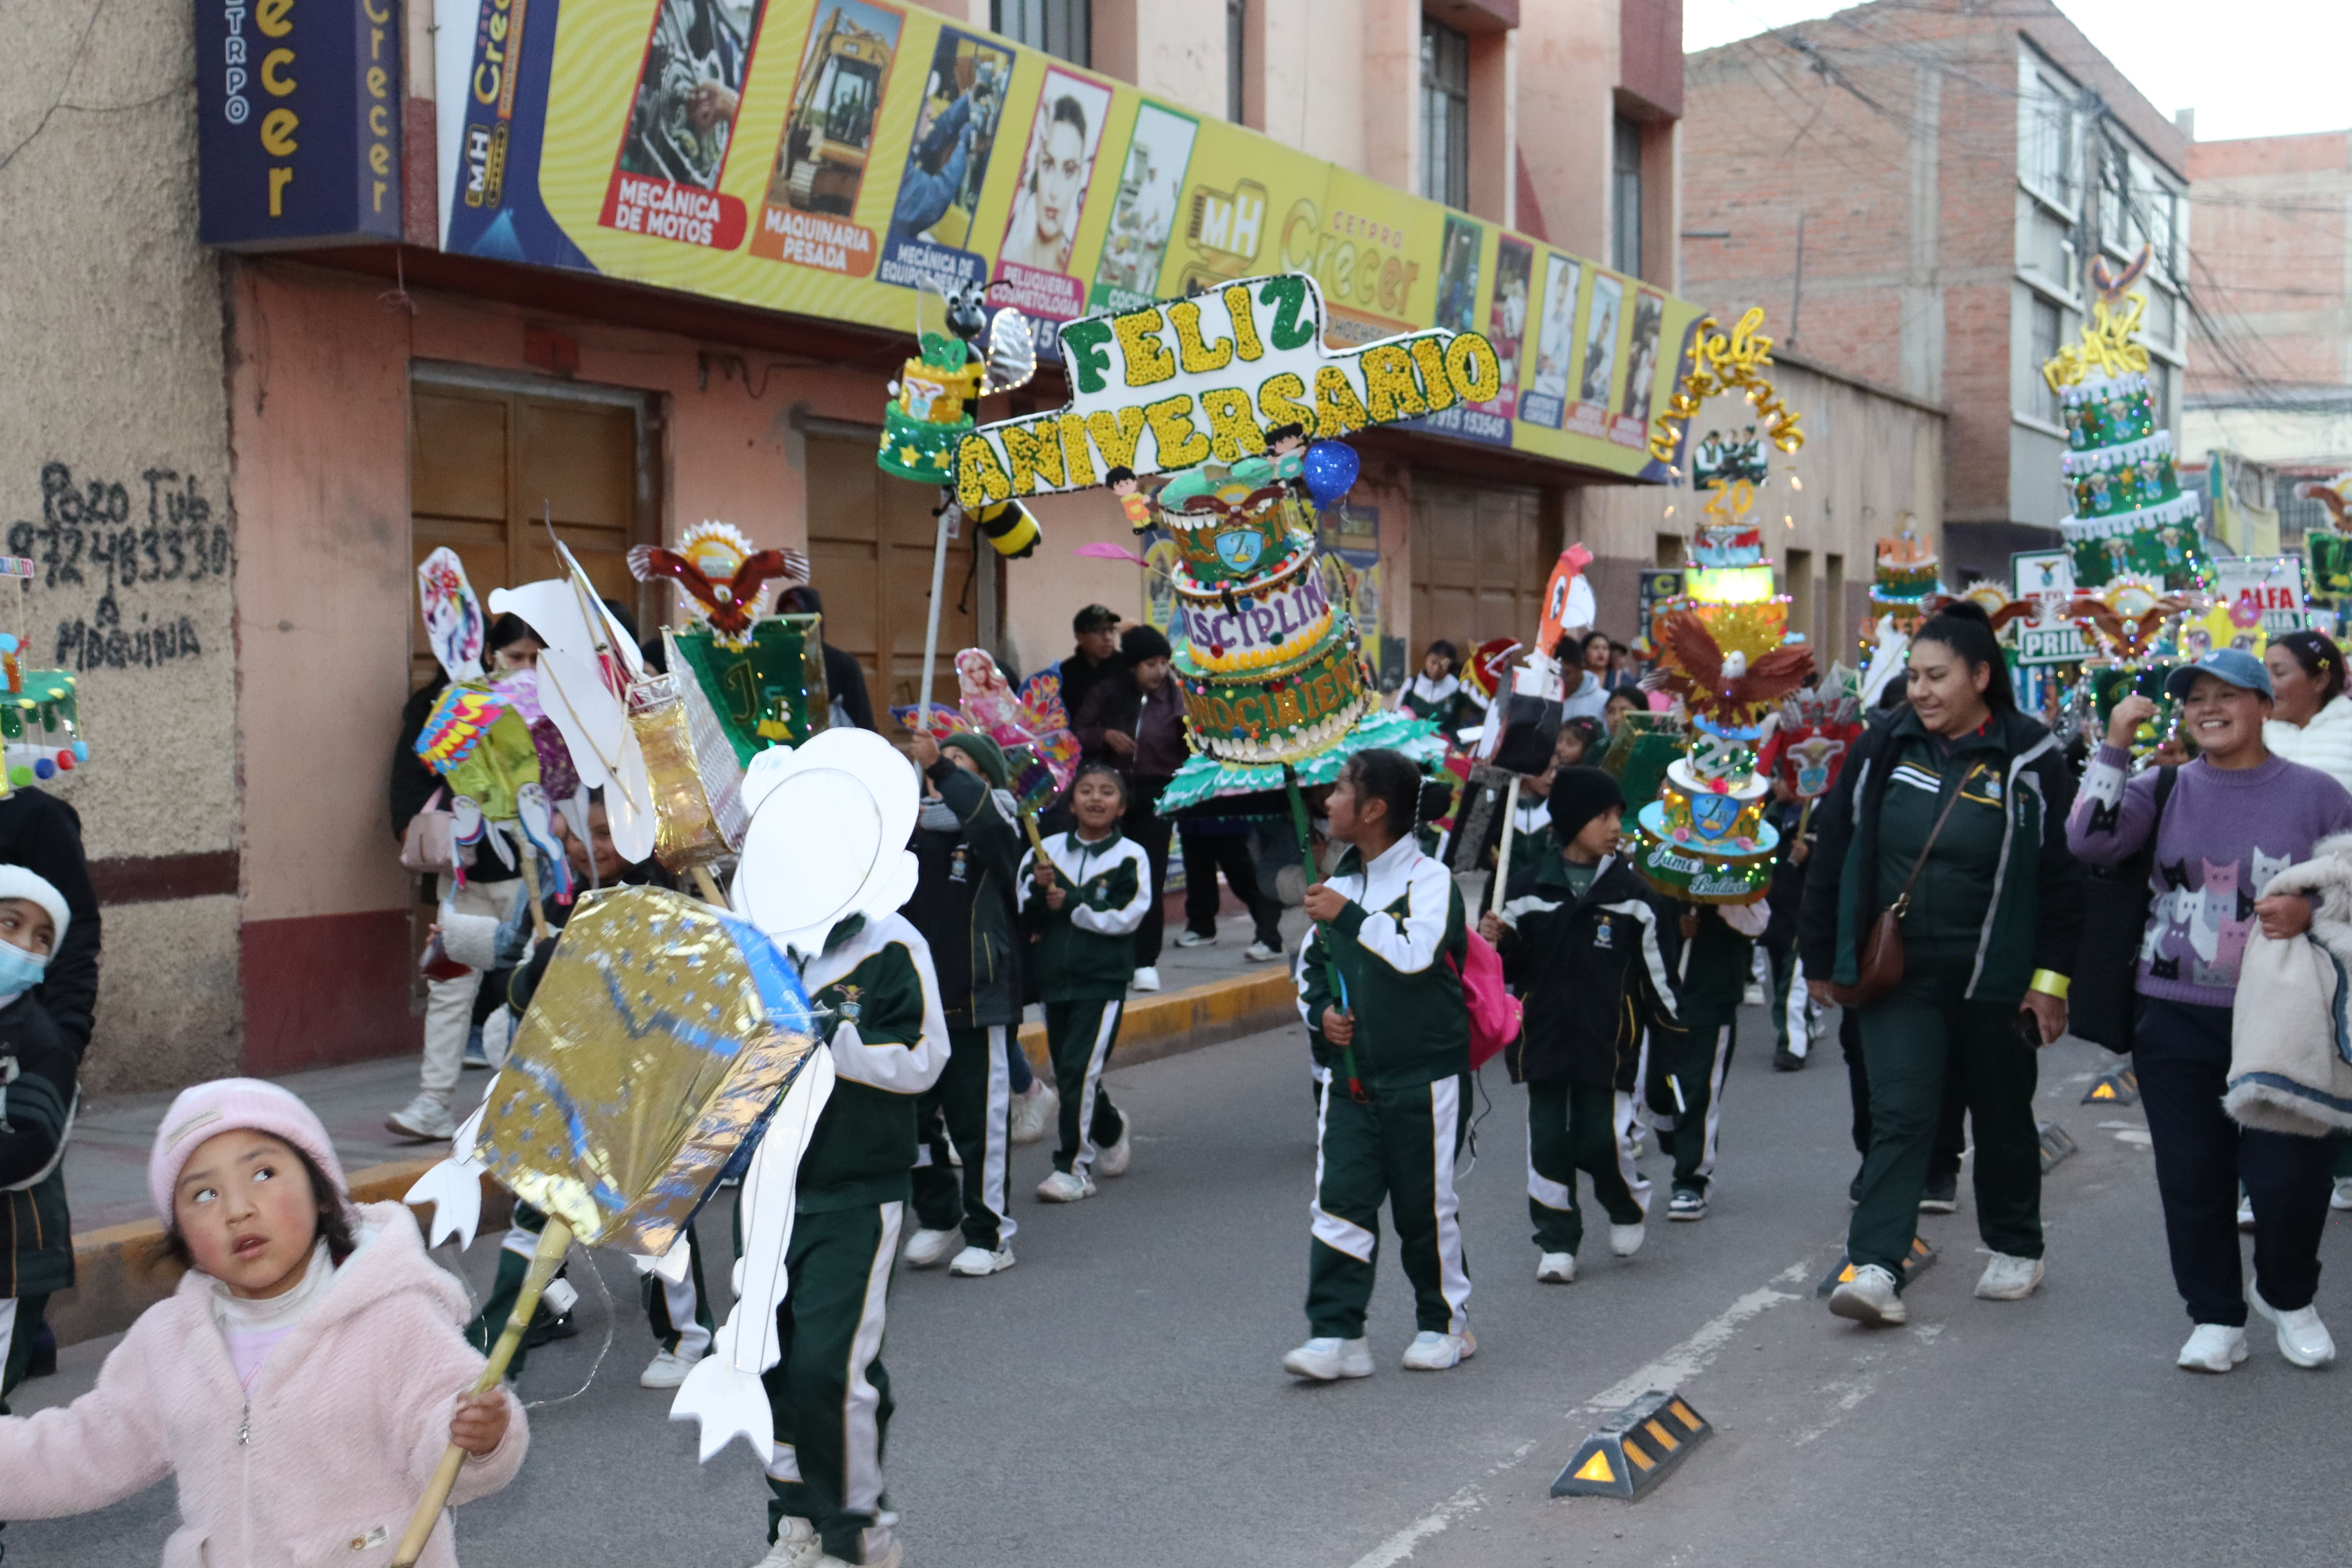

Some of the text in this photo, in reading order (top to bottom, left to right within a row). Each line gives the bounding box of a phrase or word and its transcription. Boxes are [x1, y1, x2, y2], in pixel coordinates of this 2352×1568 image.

[224, 0, 250, 125] TRPO
[469, 131, 490, 191] MH
[619, 178, 720, 222] MECÁNICA
[614, 204, 713, 246] DE MOTOS
[764, 208, 869, 252] MAQUINARIA
[1200, 195, 1263, 258] MH
[1334, 209, 1404, 249] CETPRO
[782, 237, 847, 271] PESADA
[897, 243, 975, 278] MECÁNICA DE
[1279, 198, 1419, 316] Crecer
[991, 281, 1080, 317] COSMETOLOGIA
[1003, 265, 1074, 296] PELUQUERIA
[1061, 276, 1315, 393] FELIZ
[956, 330, 1501, 509] ANIVERSARIO
[1702, 478, 1755, 515] 20
